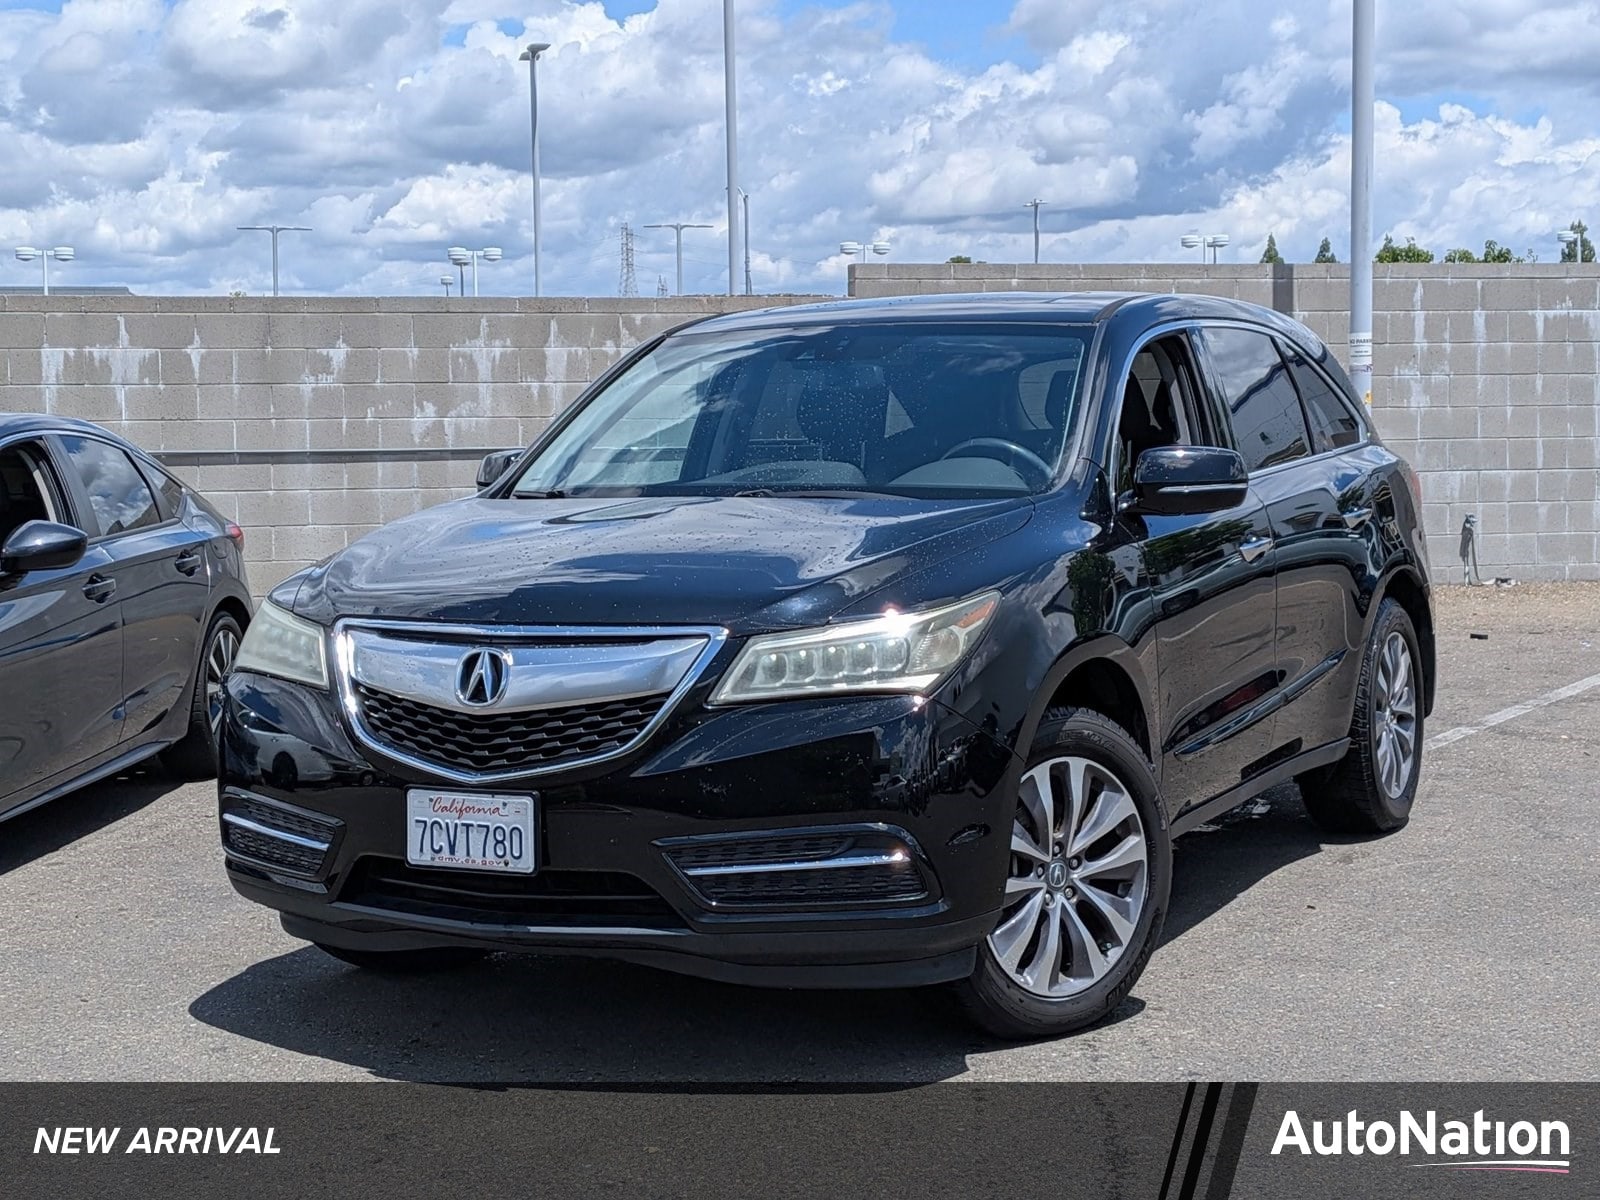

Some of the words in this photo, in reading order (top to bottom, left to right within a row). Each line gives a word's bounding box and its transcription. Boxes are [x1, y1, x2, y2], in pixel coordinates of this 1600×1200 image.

[432, 796, 508, 819] California
[415, 819, 523, 860] 7CVT780
[438, 856, 501, 866] dmv.ca.gov
